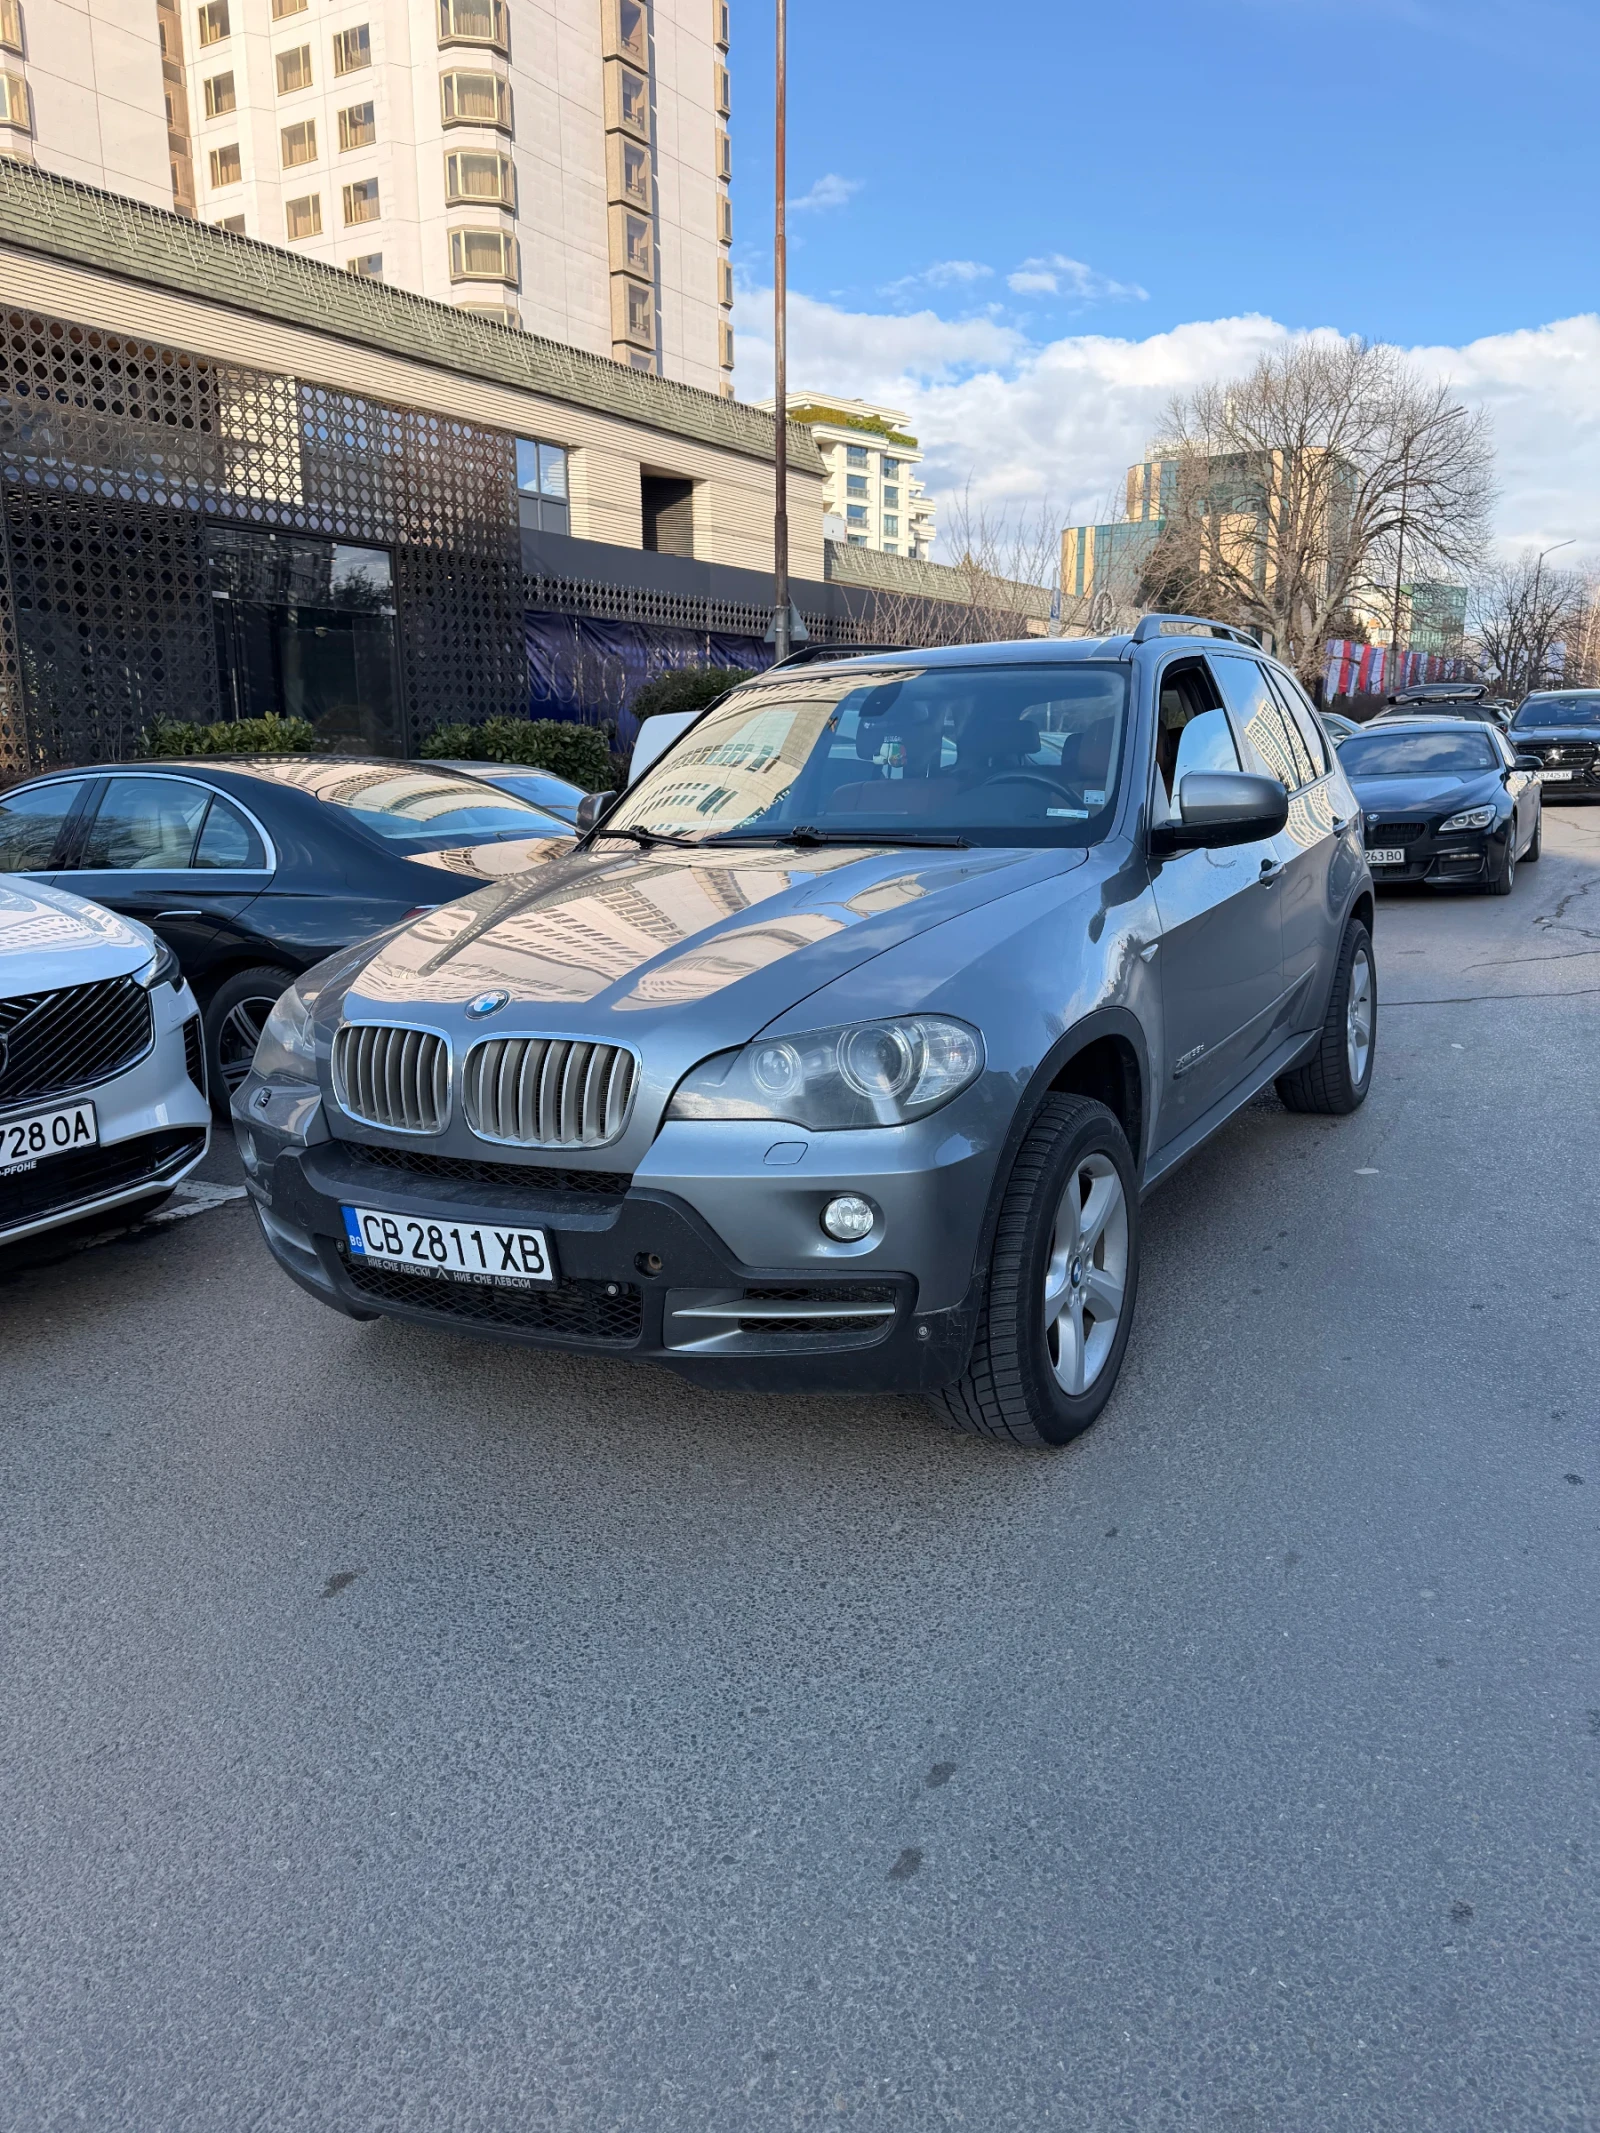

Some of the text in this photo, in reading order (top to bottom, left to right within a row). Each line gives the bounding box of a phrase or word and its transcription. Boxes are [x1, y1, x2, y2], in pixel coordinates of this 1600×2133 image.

[52, 1111, 90, 1146] OA
[350, 1235, 362, 1247] BG
[363, 1215, 545, 1274] CB 2811 XB
[368, 1257, 382, 1268] НИЕ
[382, 1260, 398, 1271] СМЕ
[400, 1264, 430, 1277] ЛЕВСКИ
[454, 1271, 471, 1282] НИЕ
[473, 1274, 492, 1285] СМЕ
[495, 1274, 531, 1289] ЛЕВСКИ
